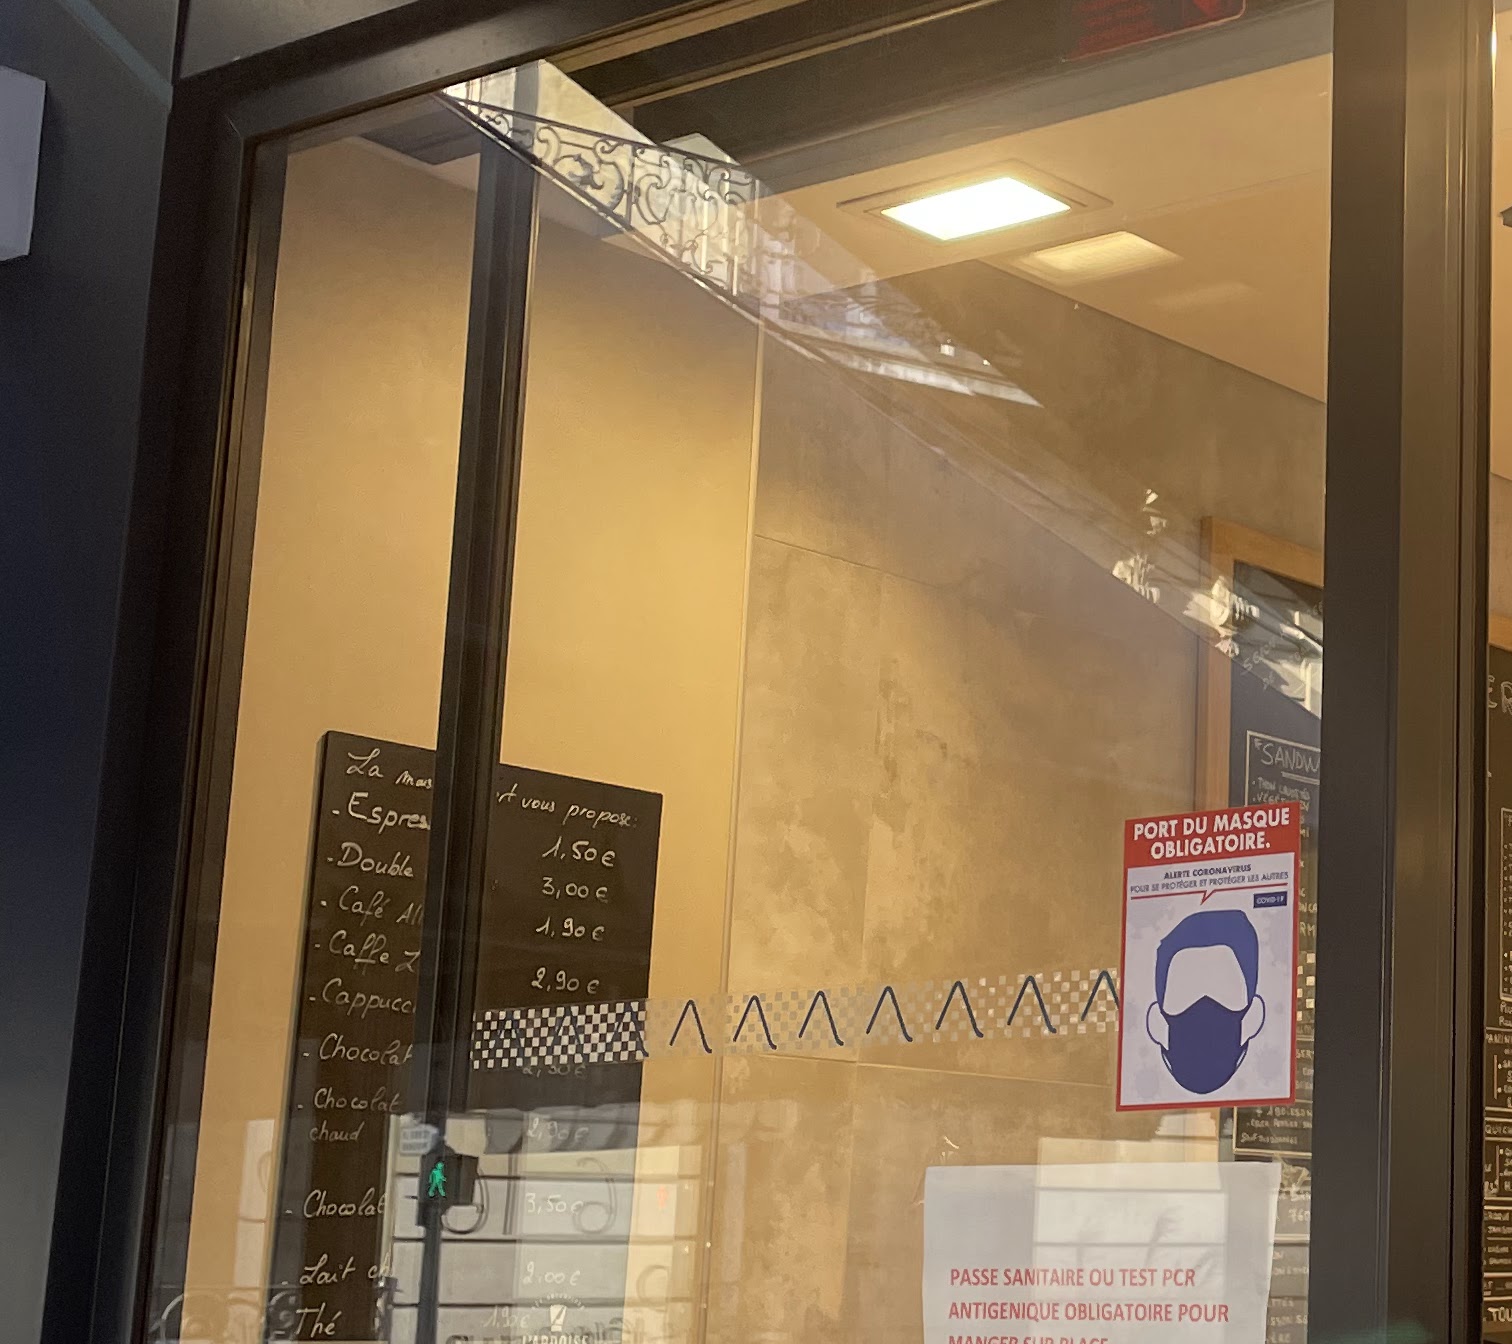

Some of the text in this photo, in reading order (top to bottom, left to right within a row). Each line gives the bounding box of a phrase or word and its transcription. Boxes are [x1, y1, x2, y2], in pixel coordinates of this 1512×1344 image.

[346, 748, 384, 778] La
[521, 797, 556, 814] vous
[1133, 817, 1178, 841] PORT
[1182, 815, 1209, 836] DU
[1212, 806, 1291, 833] MASQUE
[336, 842, 415, 879] Double
[1150, 830, 1271, 860] OBLIGATOIRE.
[1163, 863, 1252, 880] ALERTE CORONAVIRUS
[338, 885, 385, 926] Café
[318, 1031, 414, 1066] Chocolat
[313, 1086, 402, 1113] Chocolat
[309, 1120, 365, 1143] chaud
[298, 1253, 357, 1287] Lait
[950, 1268, 1196, 1288] PASSE SANITAIRE OU TEST PCR
[295, 1301, 341, 1338] Thé
[948, 1302, 1230, 1324] ANTIGENIQUE OBLIGATOIRE POUR
